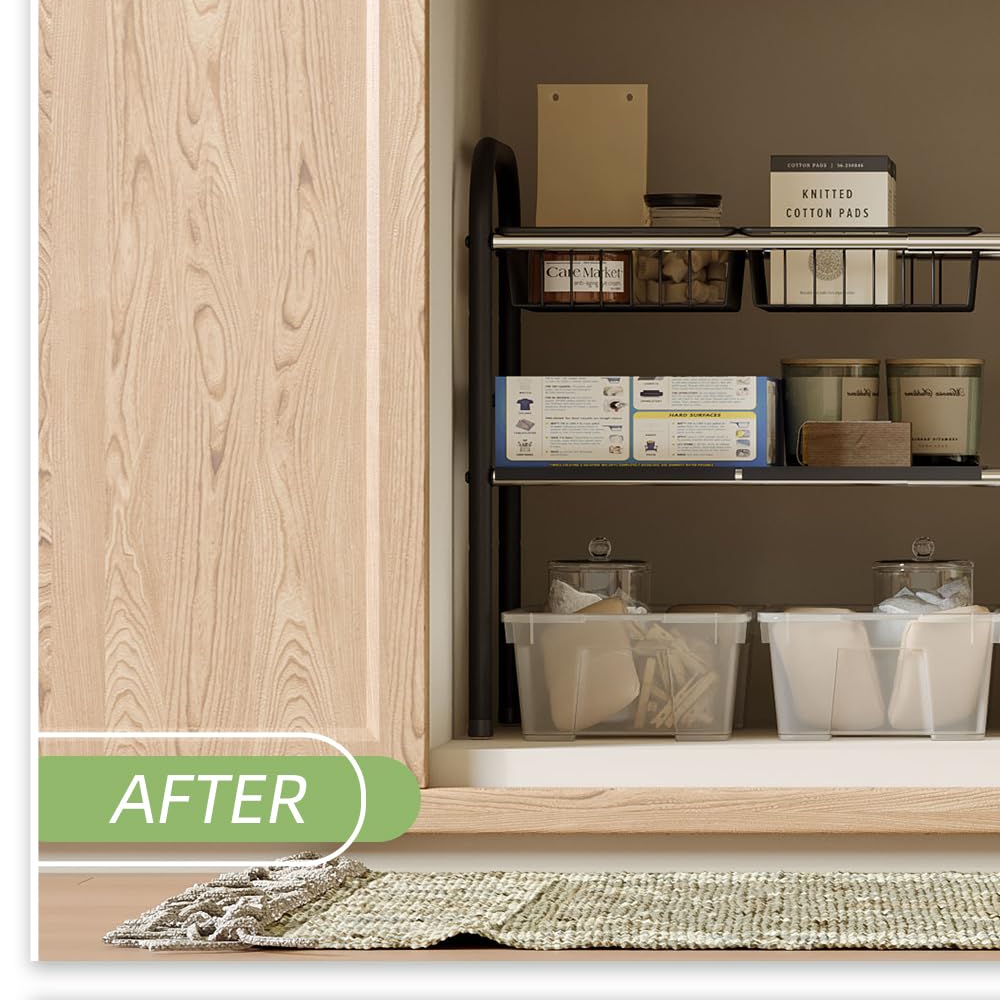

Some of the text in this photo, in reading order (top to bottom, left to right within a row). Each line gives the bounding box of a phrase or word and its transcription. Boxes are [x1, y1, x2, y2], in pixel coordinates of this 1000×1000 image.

[802, 189, 854, 199] KNITTED
[786, 208, 870, 218] COTTON PADS
[583, 266, 621, 278] Maket
